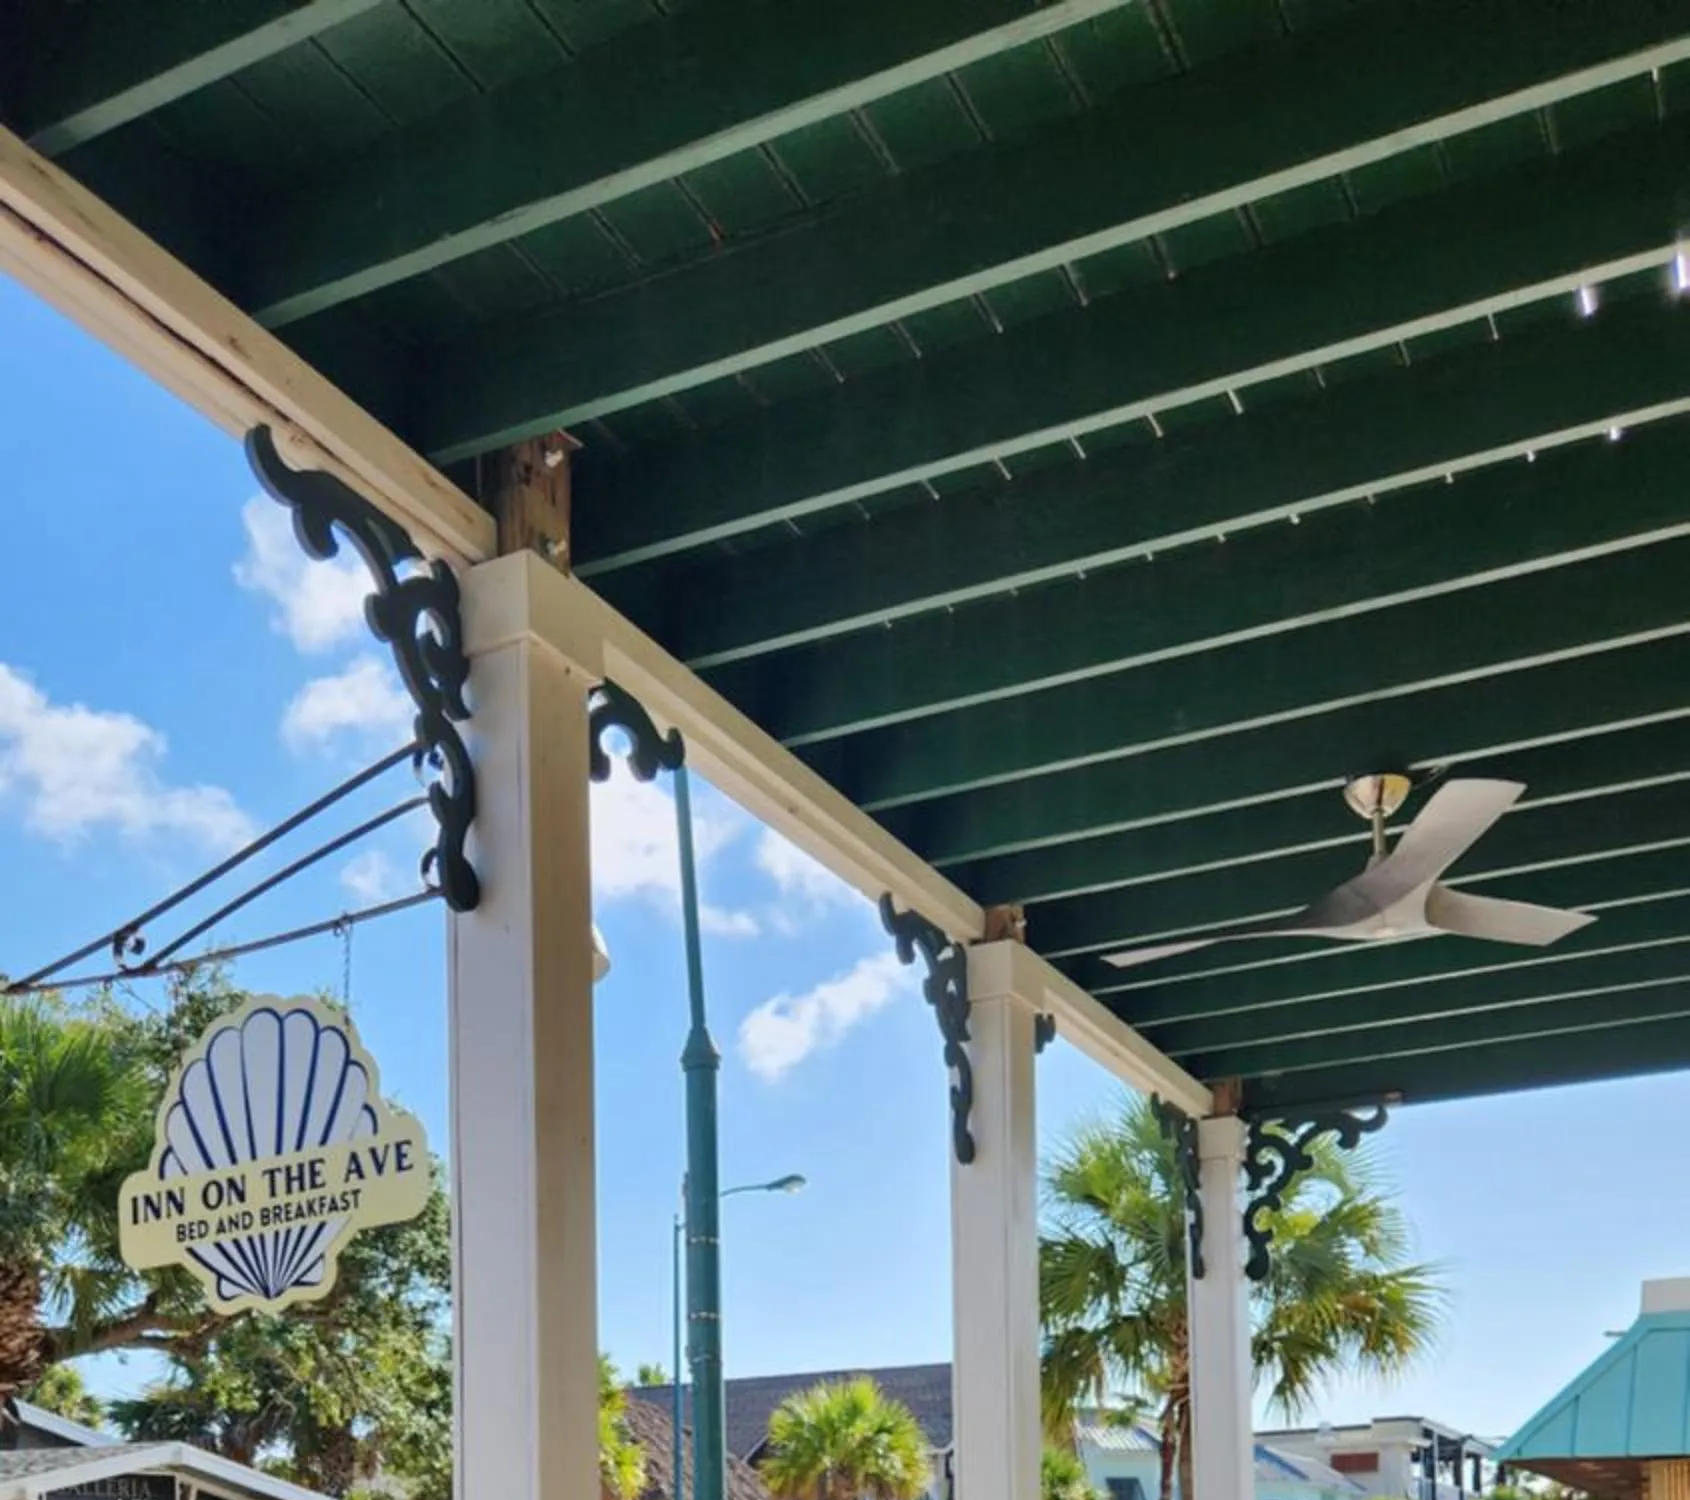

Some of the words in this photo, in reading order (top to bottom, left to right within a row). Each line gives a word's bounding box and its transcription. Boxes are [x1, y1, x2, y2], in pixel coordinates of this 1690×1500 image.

[131, 1187, 185, 1225] INN
[202, 1174, 246, 1211] ON
[262, 1158, 327, 1198] THE
[344, 1139, 414, 1183] AVE
[176, 1220, 209, 1243] BED
[215, 1211, 253, 1235] AND
[260, 1188, 362, 1227] BREAKFAST
